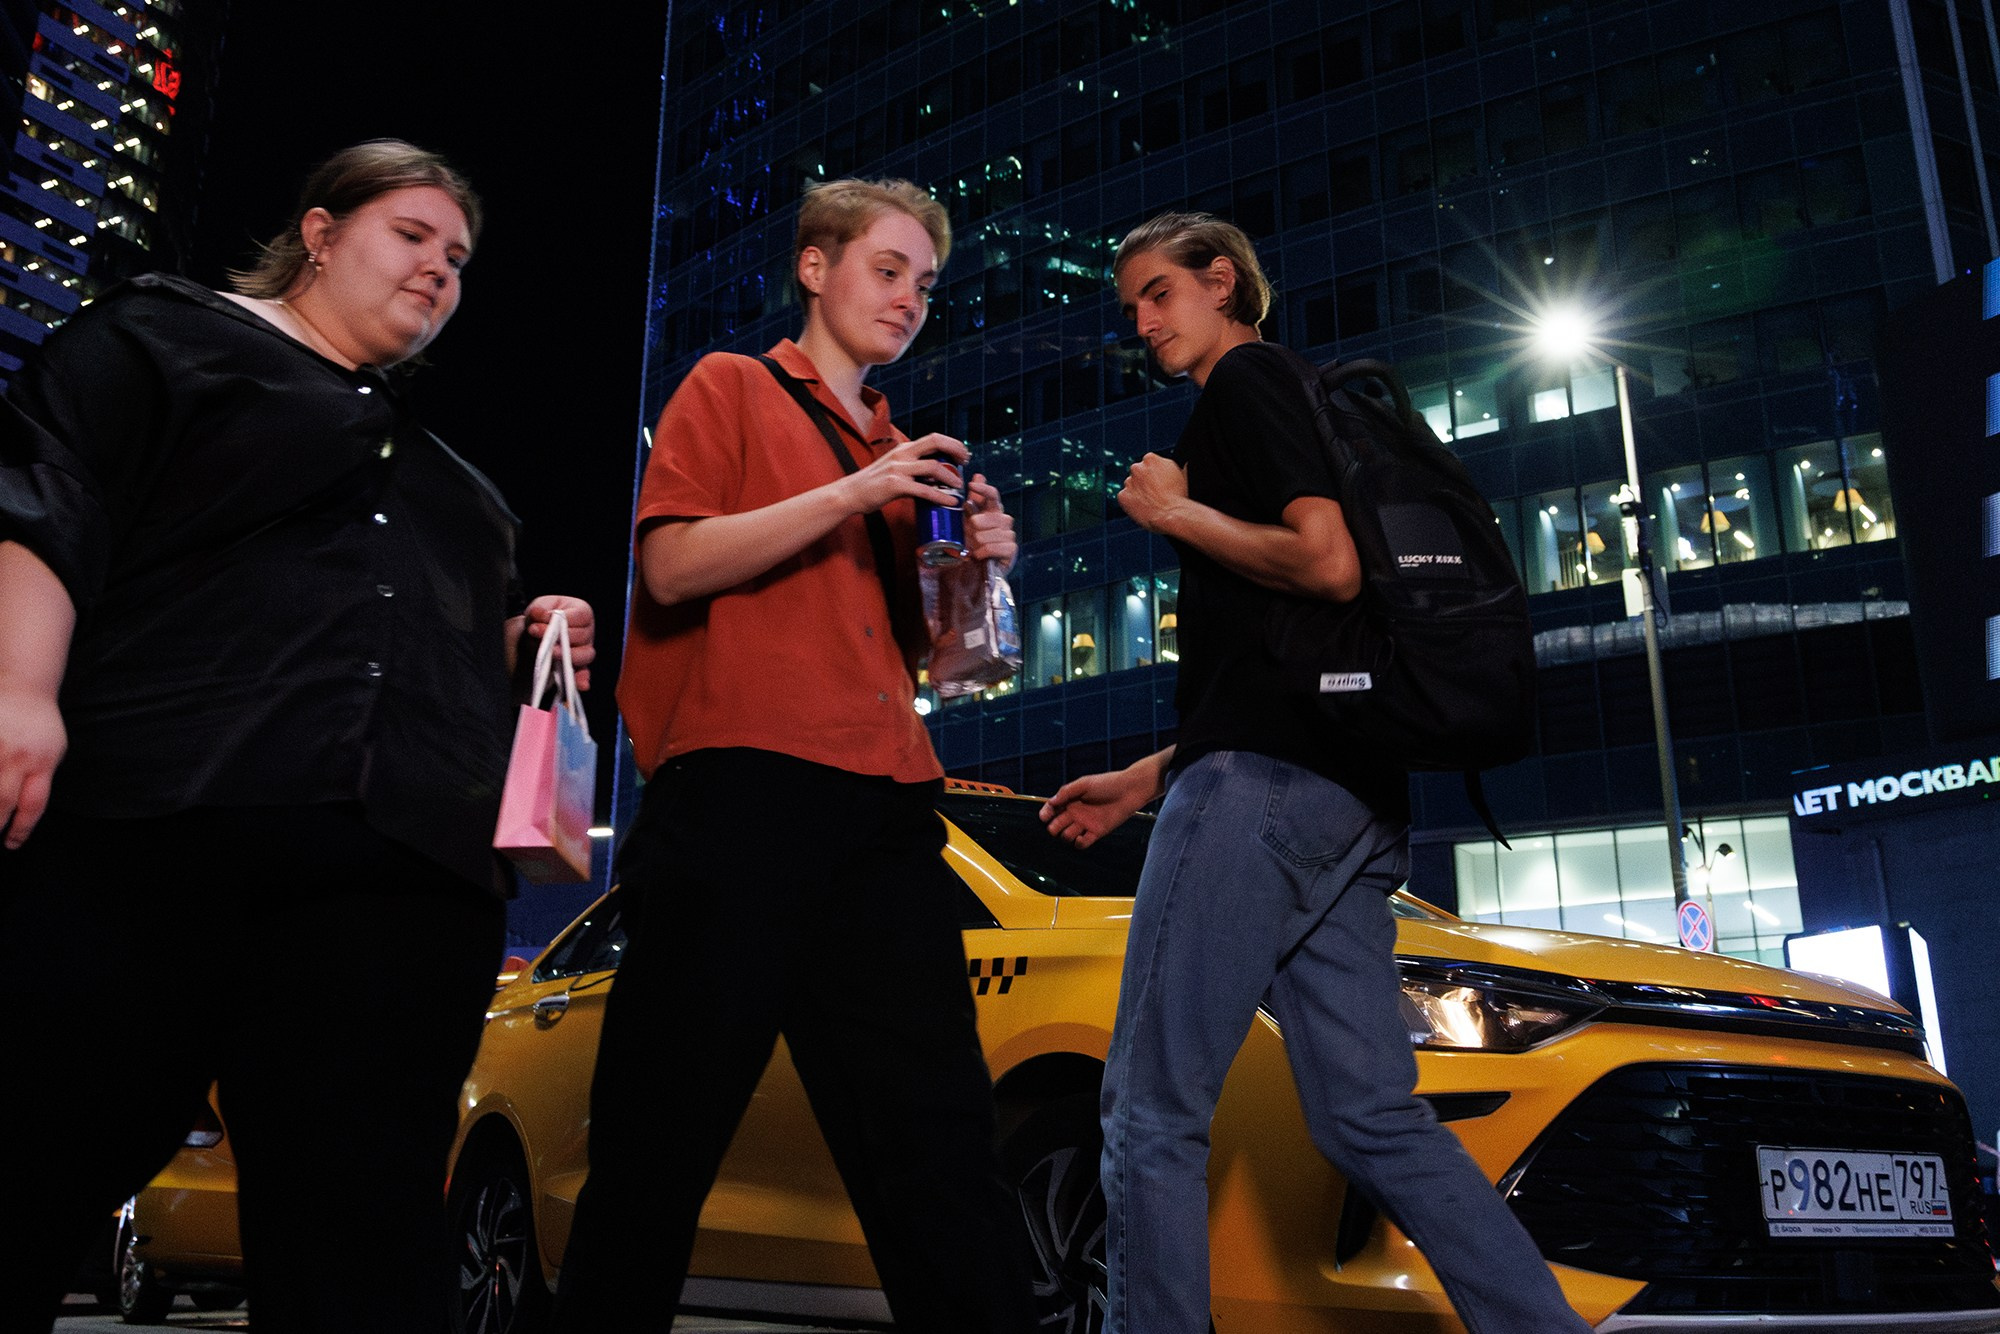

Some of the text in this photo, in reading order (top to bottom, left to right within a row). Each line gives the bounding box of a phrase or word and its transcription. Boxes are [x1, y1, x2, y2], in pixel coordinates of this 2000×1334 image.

[1398, 554, 1433, 564] LUCKY
[1895, 1160, 1937, 1199] 797
[1910, 1200, 1932, 1215] RUS
